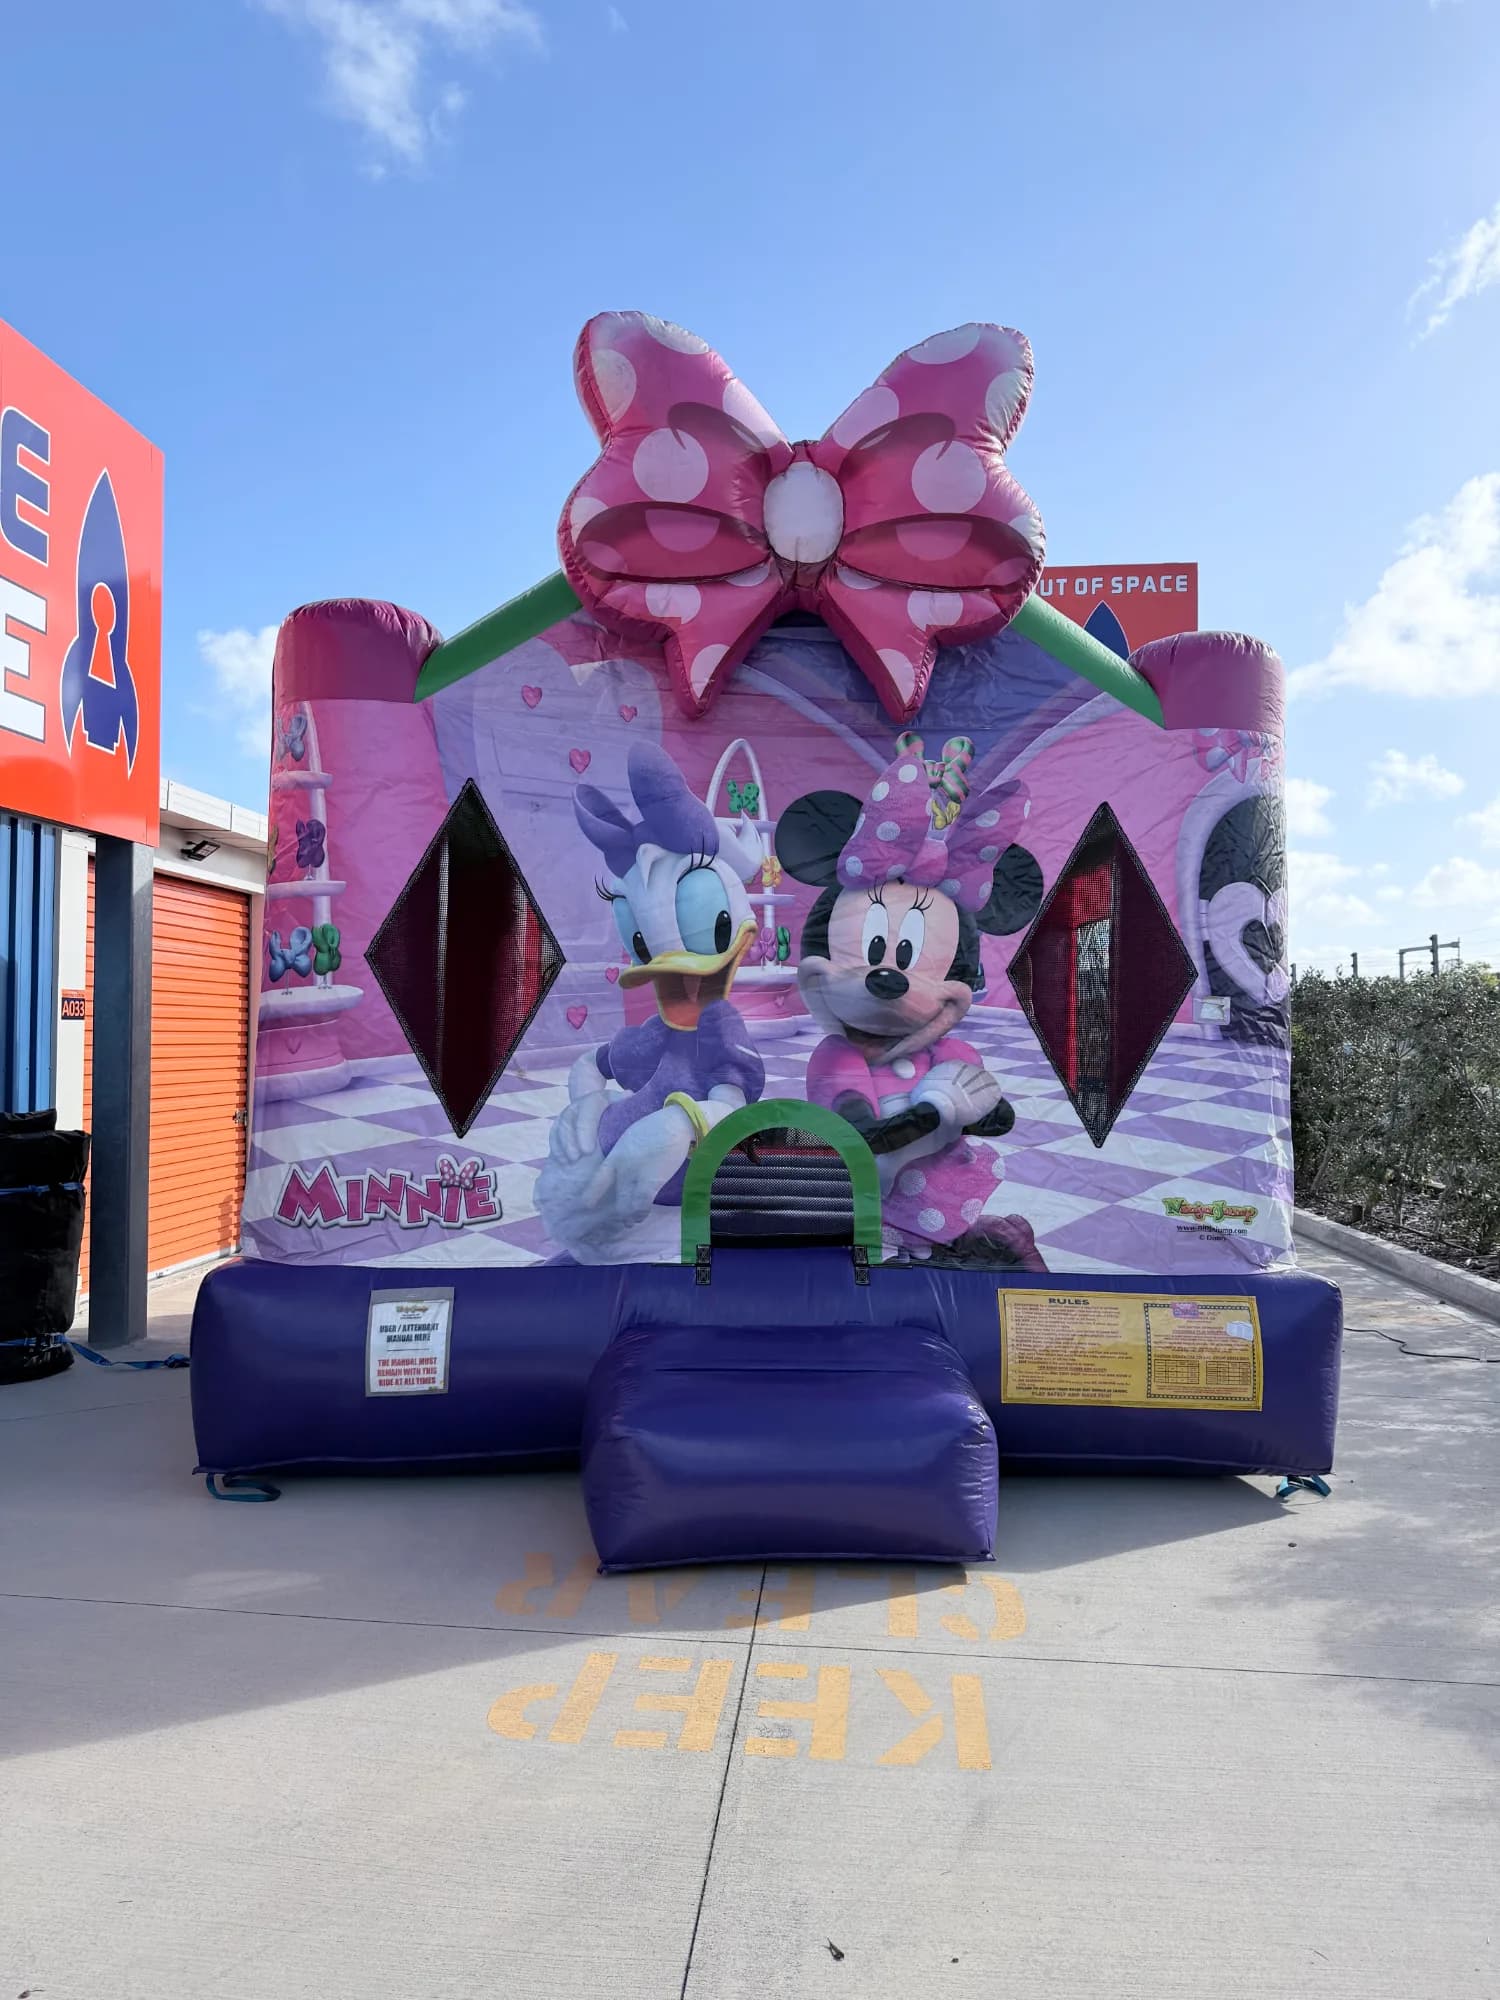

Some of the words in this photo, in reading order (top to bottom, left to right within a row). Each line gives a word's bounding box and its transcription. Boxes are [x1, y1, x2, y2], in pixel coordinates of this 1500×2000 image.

[1034, 577, 1067, 597] UT
[1074, 577, 1103, 595] OF
[1111, 574, 1188, 594] SPACE
[62, 1000, 84, 1016] A033
[276, 1163, 499, 1225] MINNIE
[1048, 1297, 1090, 1306] RULES
[379, 1325, 397, 1333] USER
[402, 1323, 440, 1332] ATTENDANT
[386, 1334, 413, 1343] MANUAL
[414, 1333, 431, 1341] HERE
[391, 1358, 418, 1366] MANUAL
[419, 1357, 438, 1365] MUST
[403, 1368, 421, 1376] WITH
[422, 1367, 438, 1375] THIS
[486, 1652, 992, 1770] KEEP
